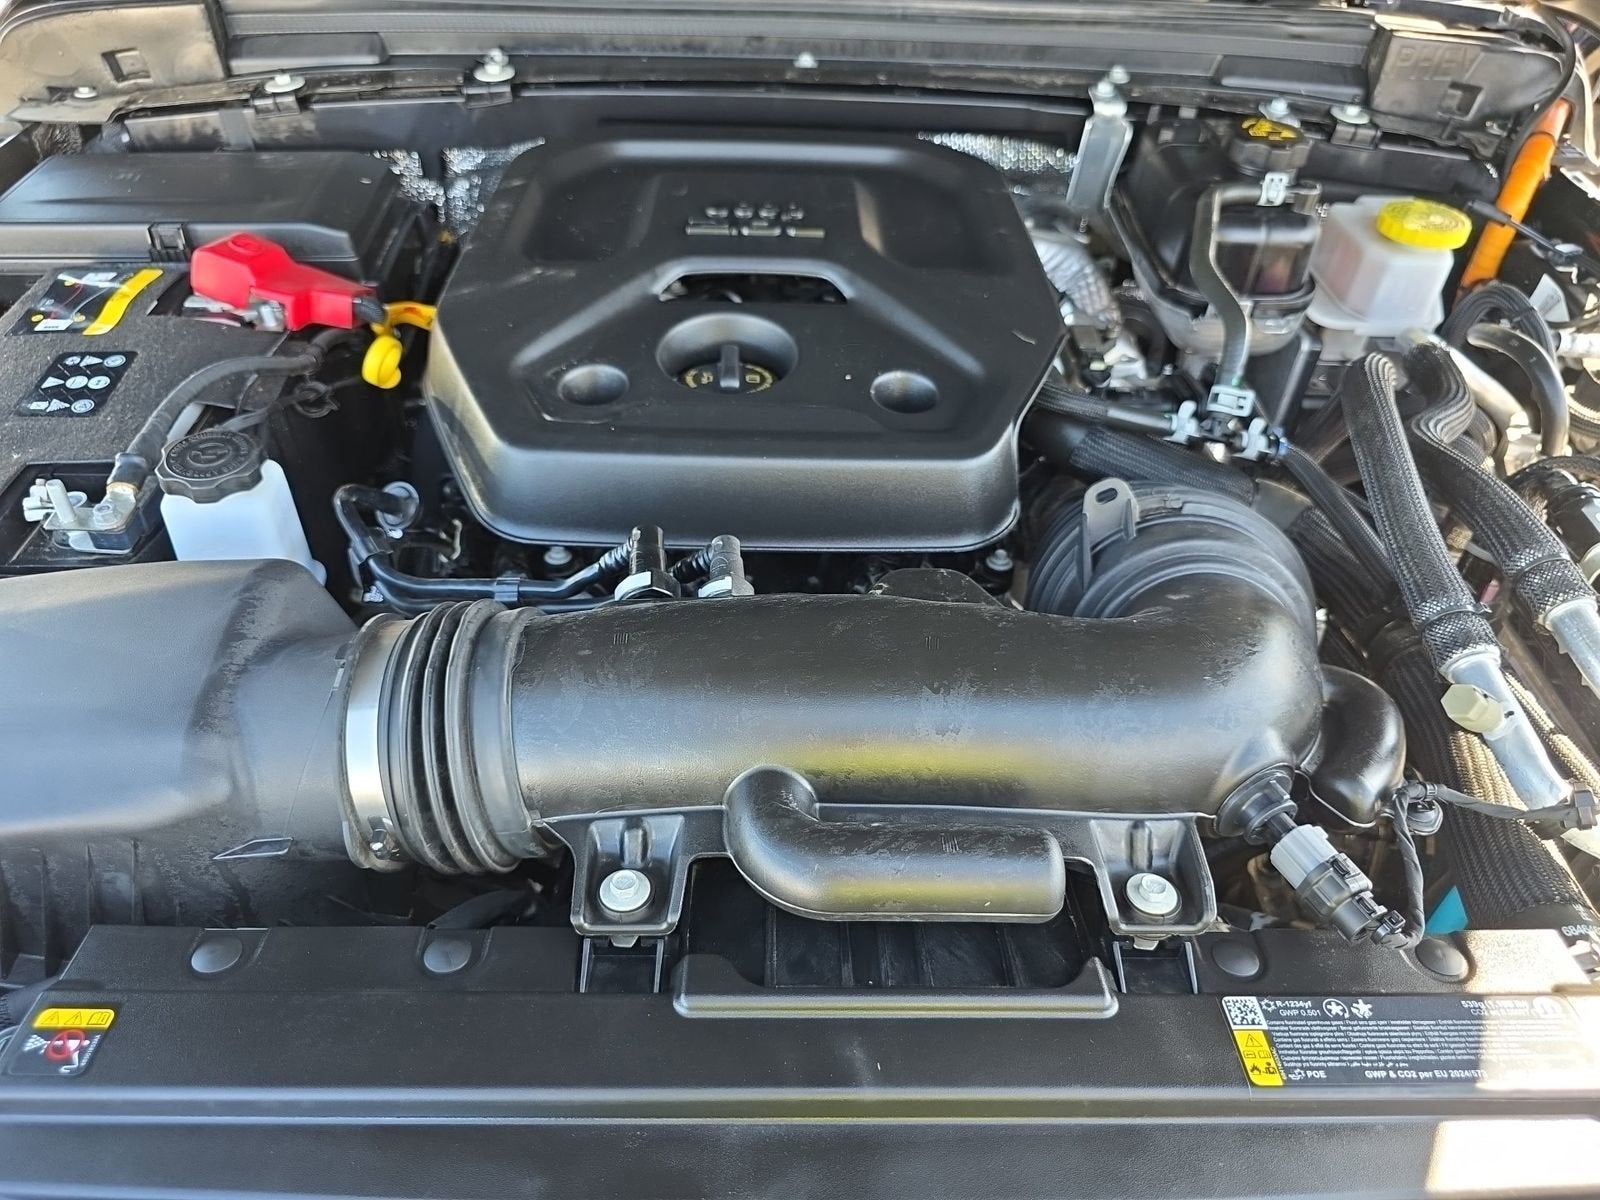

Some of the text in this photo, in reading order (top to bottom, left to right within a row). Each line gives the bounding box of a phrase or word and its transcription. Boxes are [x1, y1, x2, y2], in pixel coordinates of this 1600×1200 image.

[1364, 1071, 1386, 1079] GWP
[1397, 1070, 1418, 1078] CO2
[1418, 1071, 1433, 1080] per
[1433, 1070, 1448, 1078] EU
